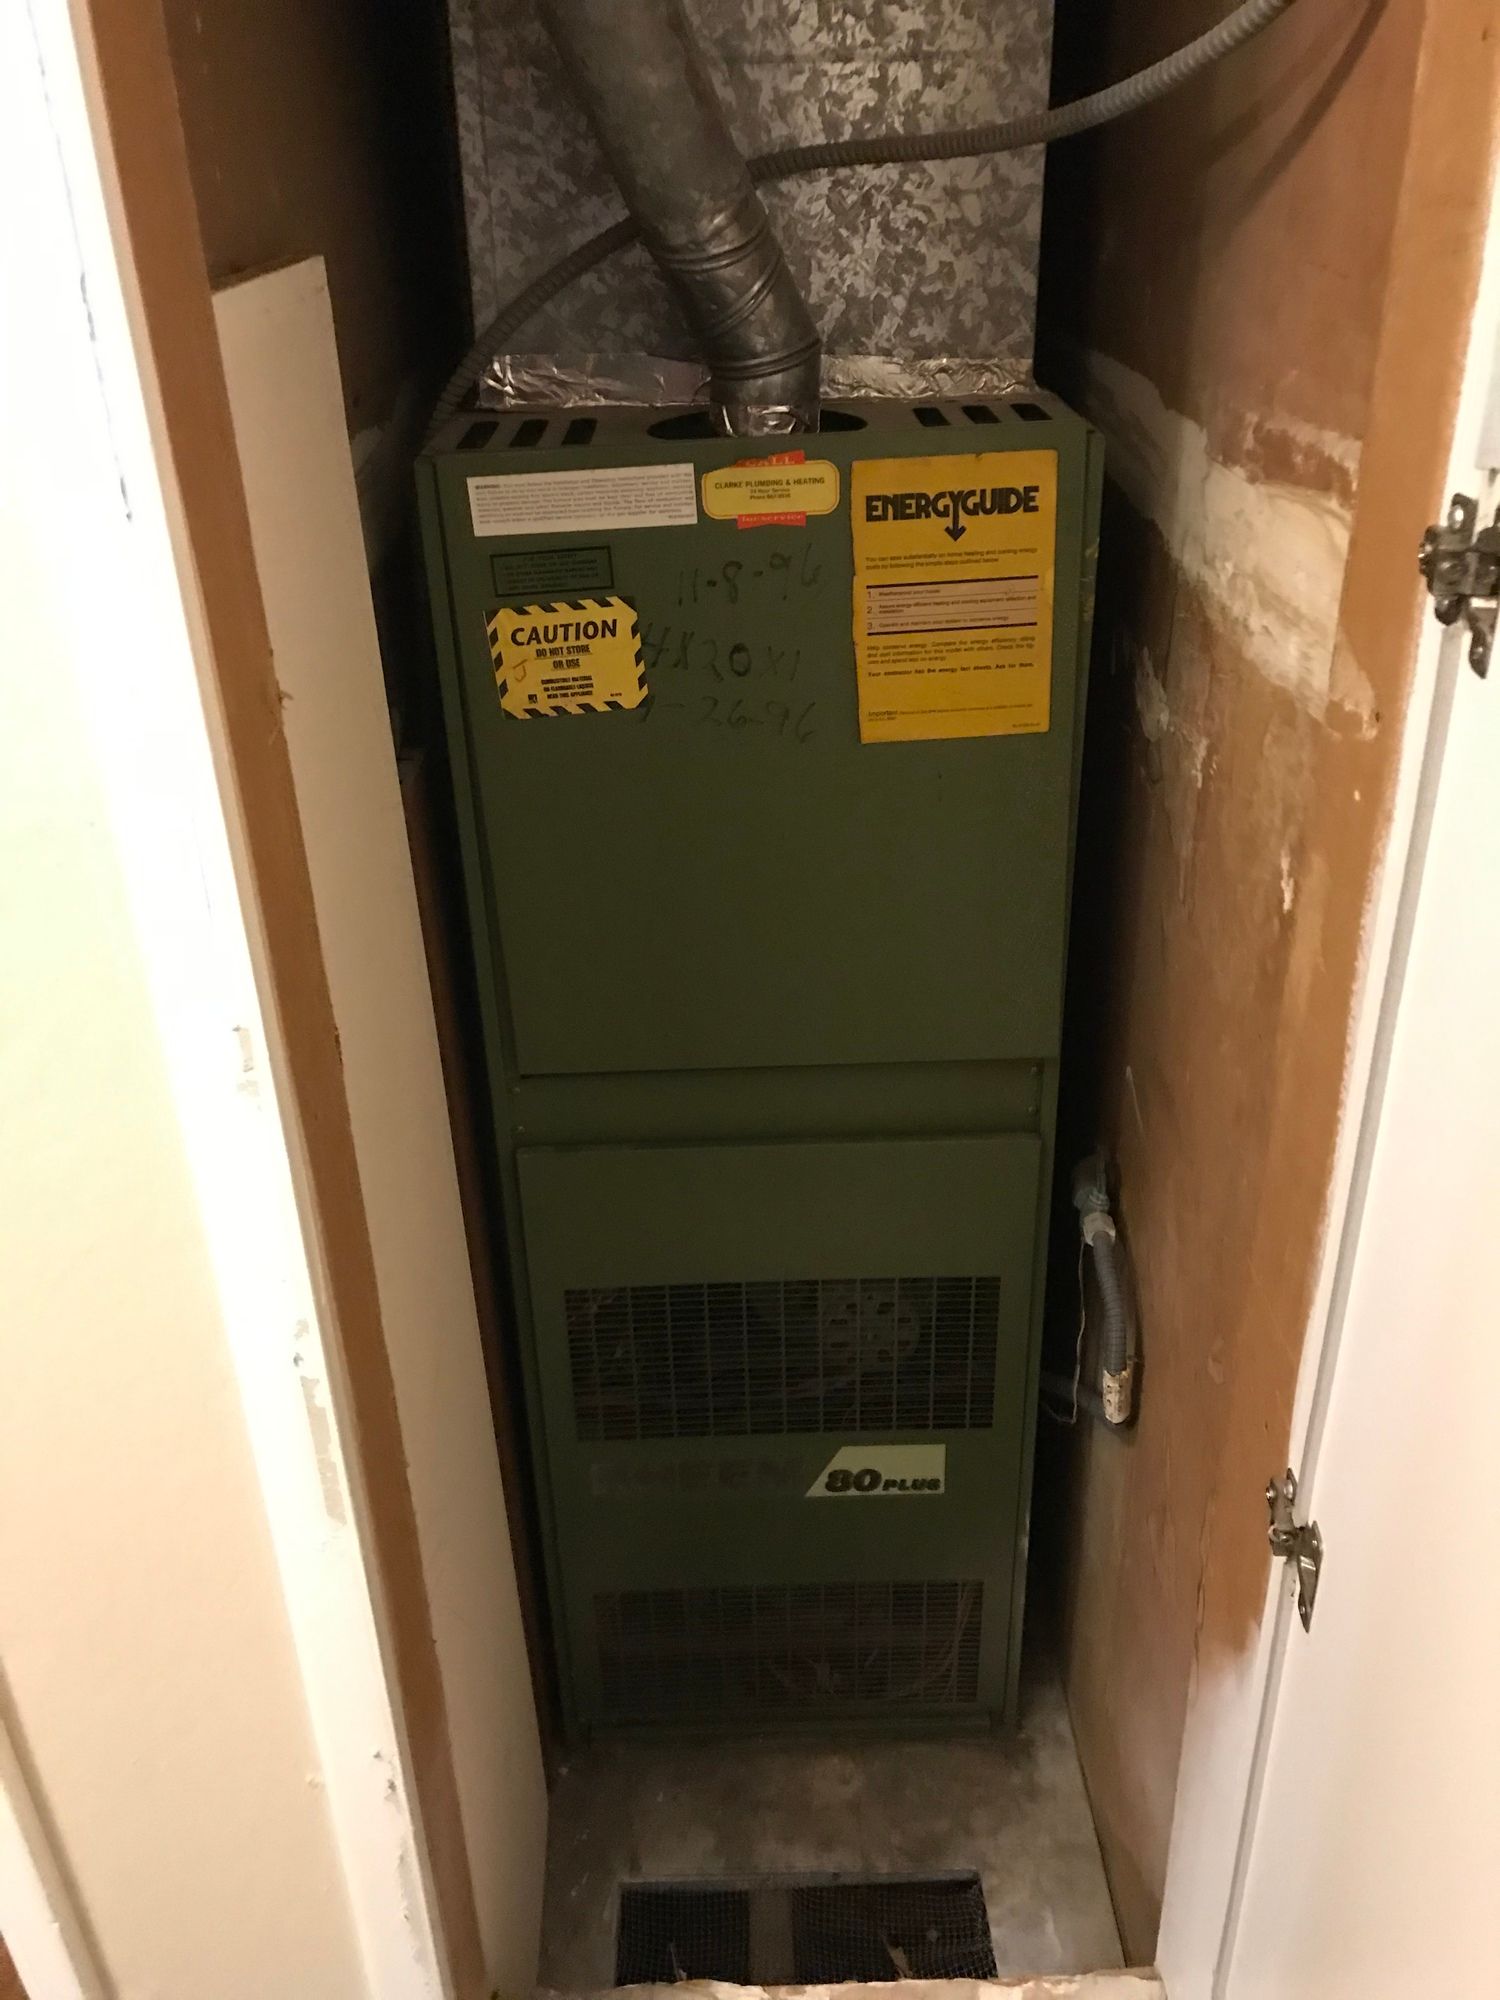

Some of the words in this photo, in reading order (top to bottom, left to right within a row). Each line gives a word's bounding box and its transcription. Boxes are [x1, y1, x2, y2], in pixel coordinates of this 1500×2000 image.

[715, 480, 742, 490] CLARKE
[745, 479, 783, 488] PLUMBING
[793, 477, 825, 485] HEATING
[866, 486, 1040, 532] ENERGYGUIDE
[510, 619, 618, 646] CAUTION
[536, 648, 547, 658] DO
[550, 646, 564, 656] NOT
[566, 644, 590, 655] STORE
[553, 660, 564, 669] OR
[566, 658, 580, 668] USE
[825, 1468, 882, 1493] 80
[882, 1478, 941, 1491] PLUS
